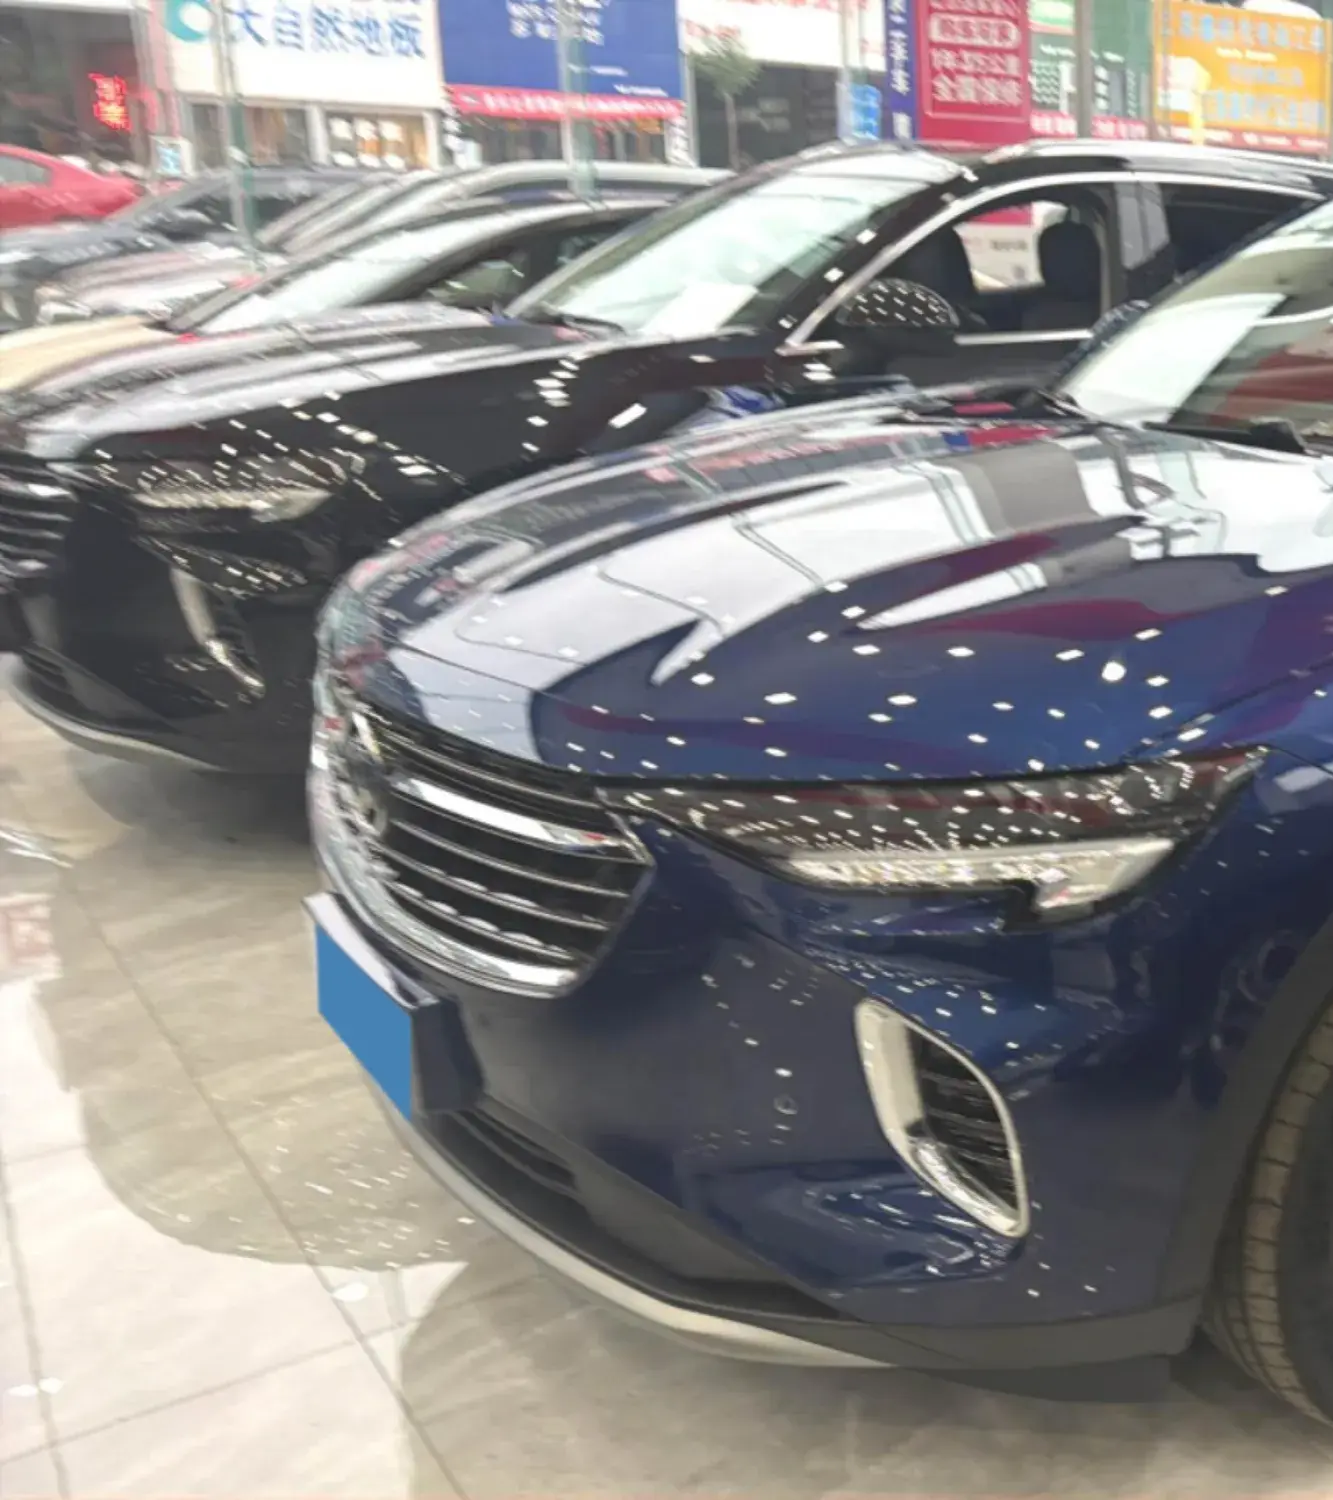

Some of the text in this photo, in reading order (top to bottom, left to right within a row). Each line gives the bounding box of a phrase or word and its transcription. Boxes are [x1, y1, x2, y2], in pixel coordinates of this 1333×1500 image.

[224, 0, 427, 59] 大自然地板
